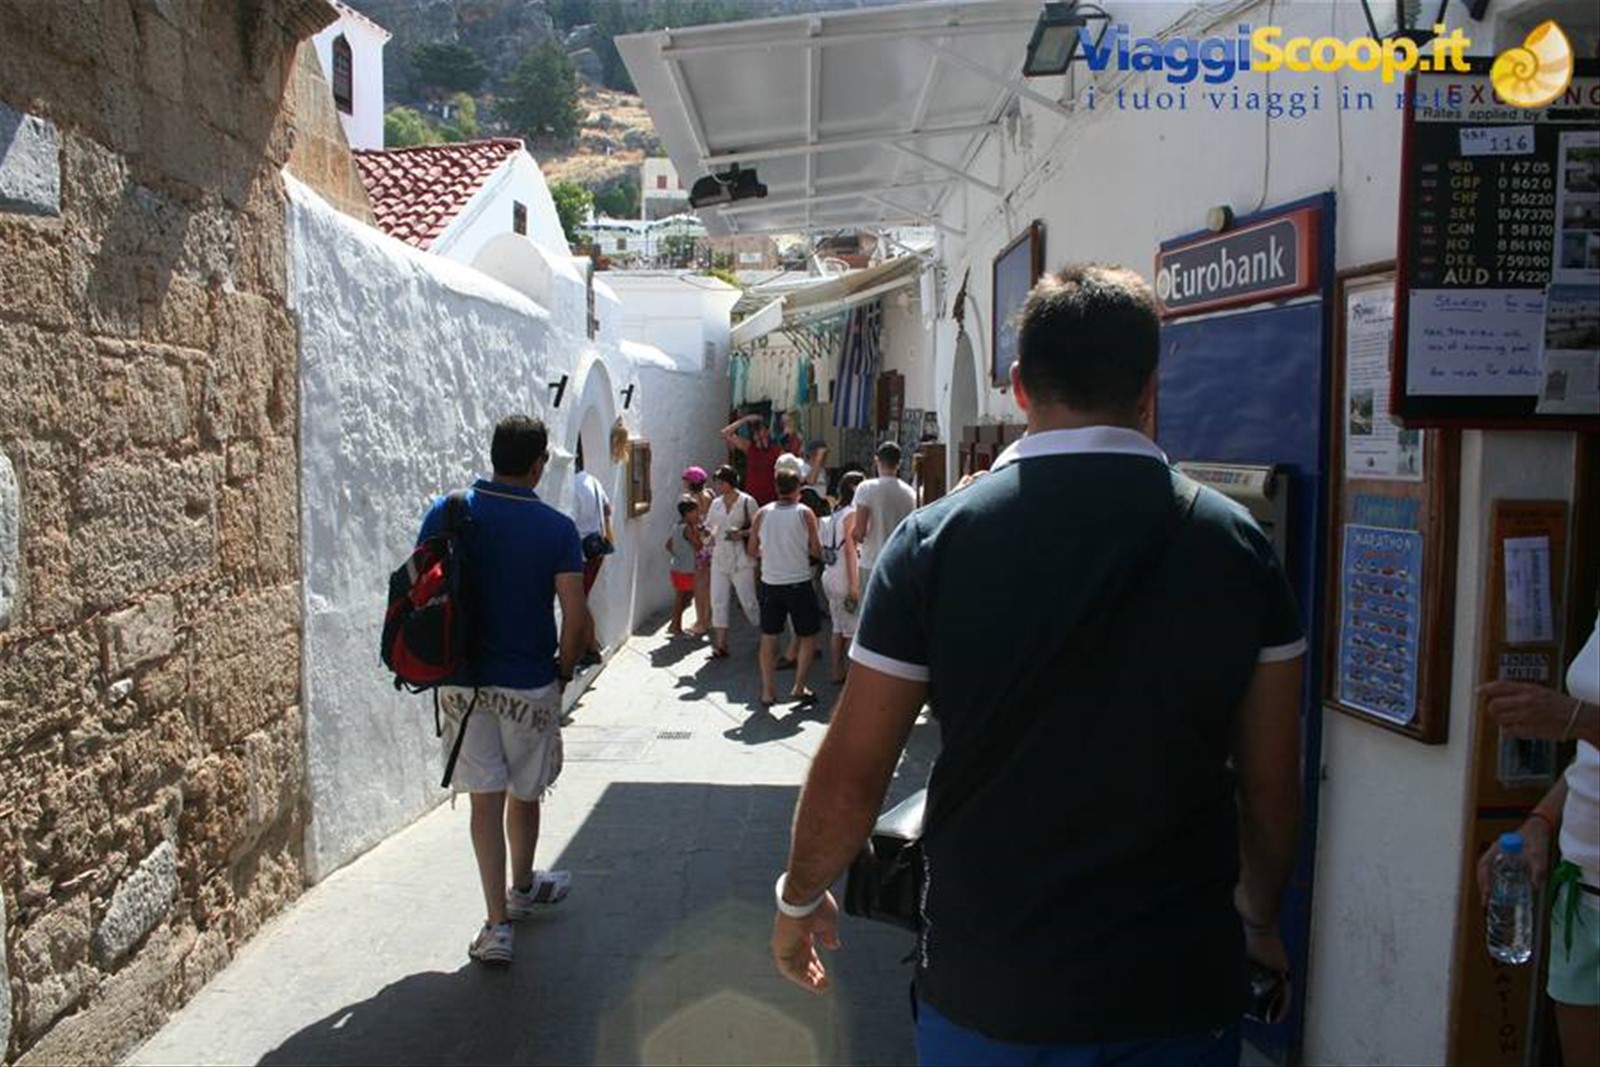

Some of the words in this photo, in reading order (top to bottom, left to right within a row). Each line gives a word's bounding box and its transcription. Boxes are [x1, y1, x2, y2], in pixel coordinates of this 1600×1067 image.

[1423, 107, 1461, 119] Rates
[1468, 109, 1517, 121] applied
[1523, 108, 1540, 121] by
[1170, 234, 1286, 300] Eurobank
[1442, 267, 1491, 285] AUD
